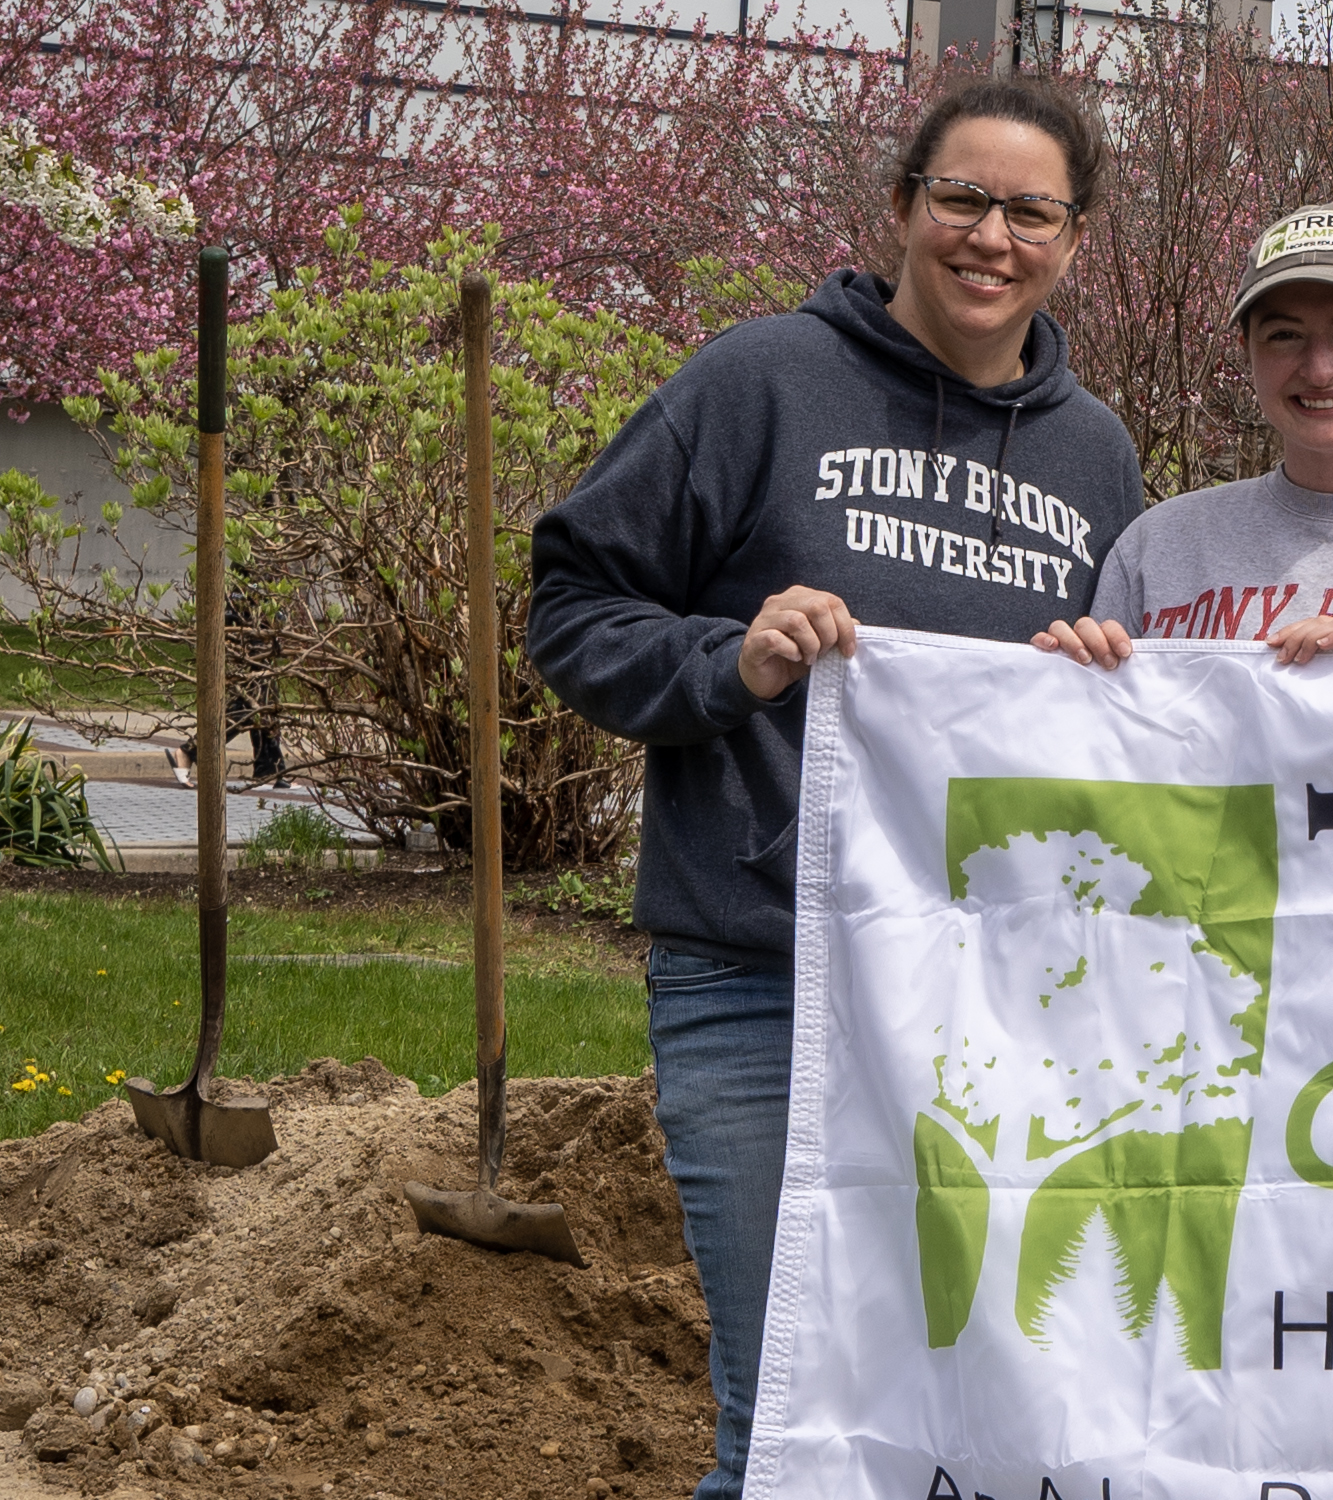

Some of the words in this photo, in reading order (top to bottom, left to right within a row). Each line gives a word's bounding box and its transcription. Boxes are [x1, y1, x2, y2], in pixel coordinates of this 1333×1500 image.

[1285, 241, 1316, 251] HIGHER
[815, 448, 957, 503] STONY
[964, 460, 1094, 569] BROOK
[846, 508, 1073, 600] UNIVERSITY
[1143, 584, 1299, 641] TONY
